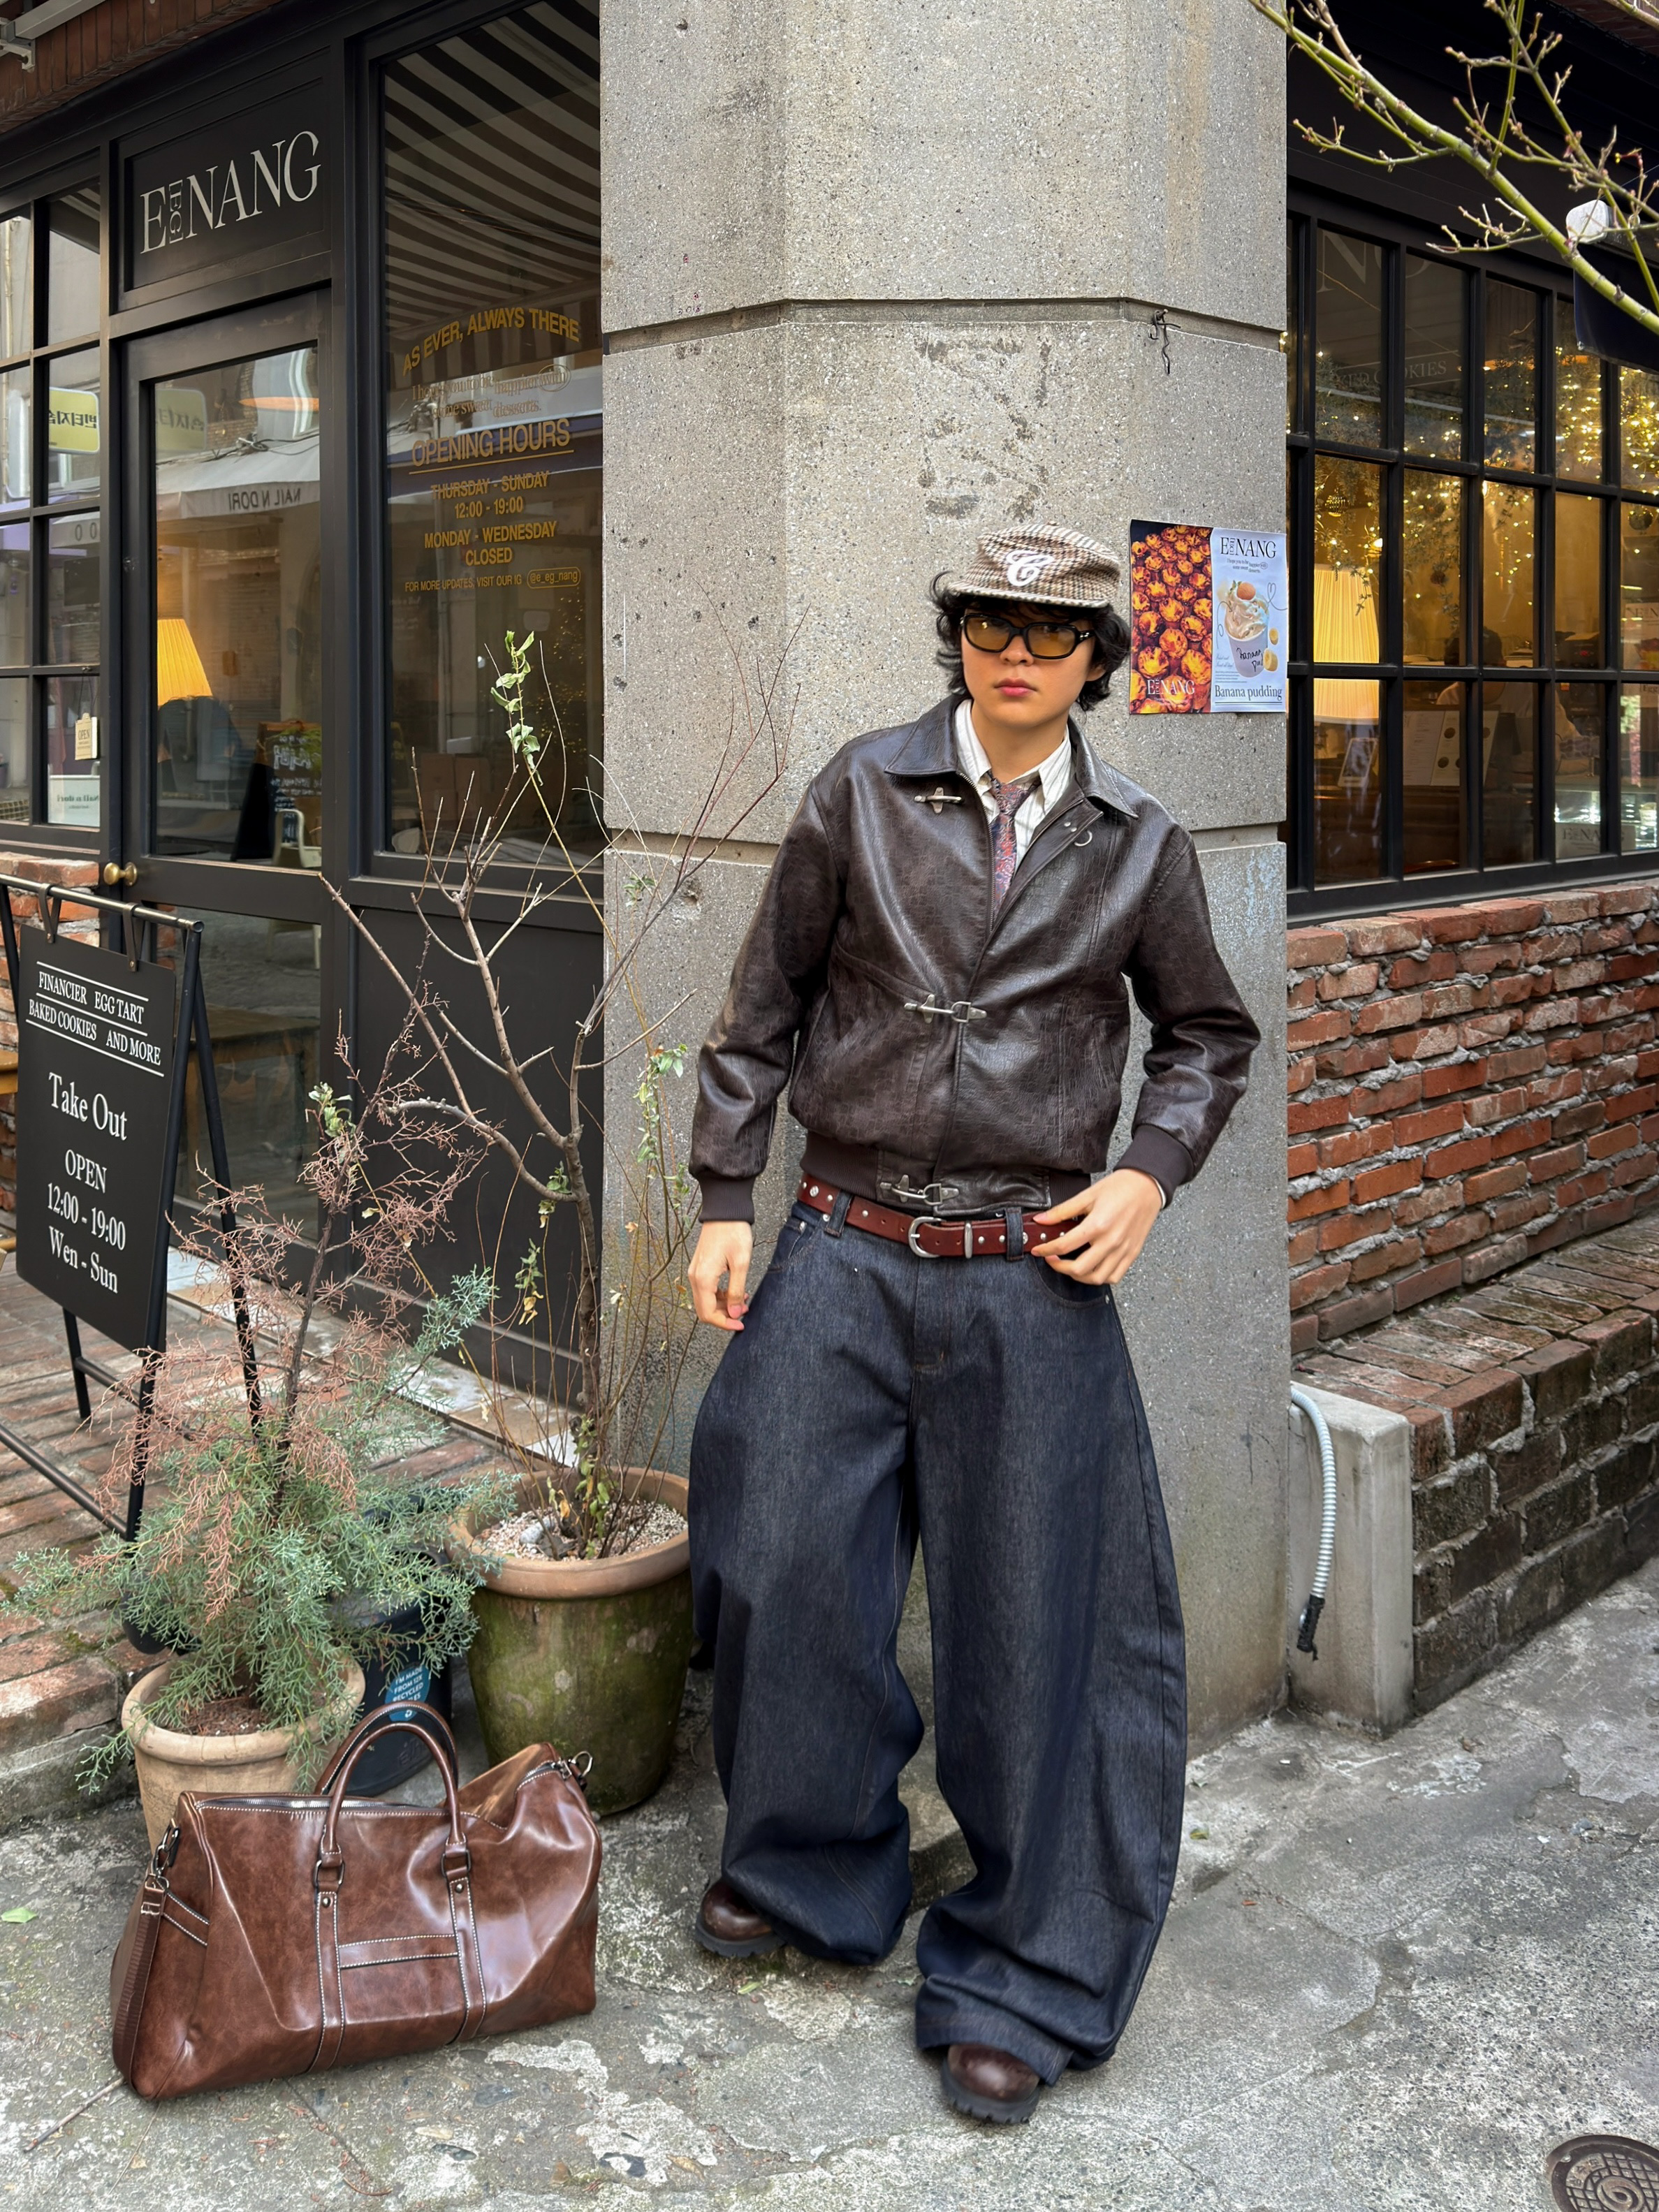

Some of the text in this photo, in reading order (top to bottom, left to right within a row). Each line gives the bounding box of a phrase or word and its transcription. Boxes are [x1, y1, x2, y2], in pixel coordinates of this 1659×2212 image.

[402, 307, 580, 376] AS EVER, ALWAYS THERE
[412, 418, 570, 467] OPENING HOURS
[430, 478, 489, 499] THURSDAY
[502, 471, 550, 492] SUNDAY
[455, 501, 483, 518] 12:00
[493, 496, 523, 515] 19:00
[424, 529, 471, 548] MONDAY
[482, 521, 557, 543] WEDNESDAY
[465, 548, 513, 566] CLOSED
[404, 583, 419, 592] FOR
[421, 580, 440, 591] MORE
[476, 576, 494, 587] VISIT
[496, 575, 512, 586] OUR
[514, 574, 522, 585] IG
[529, 571, 578, 584] @e_eg_nang
[1215, 684, 1282, 701] Banana pudding
[78, 729, 90, 740] OPEN
[38, 971, 144, 1025] FINANCIER EGG TART
[29, 998, 161, 1066] BAKED COOKIES AND MORE
[48, 1071, 127, 1141] Take Out
[64, 1149, 107, 1194] OPEN
[47, 1182, 79, 1224] 12:00
[91, 1207, 126, 1251] 19:00
[48, 1226, 78, 1269] Wen
[90, 1252, 118, 1294] Sun
[394, 1680, 413, 1694] FROM
